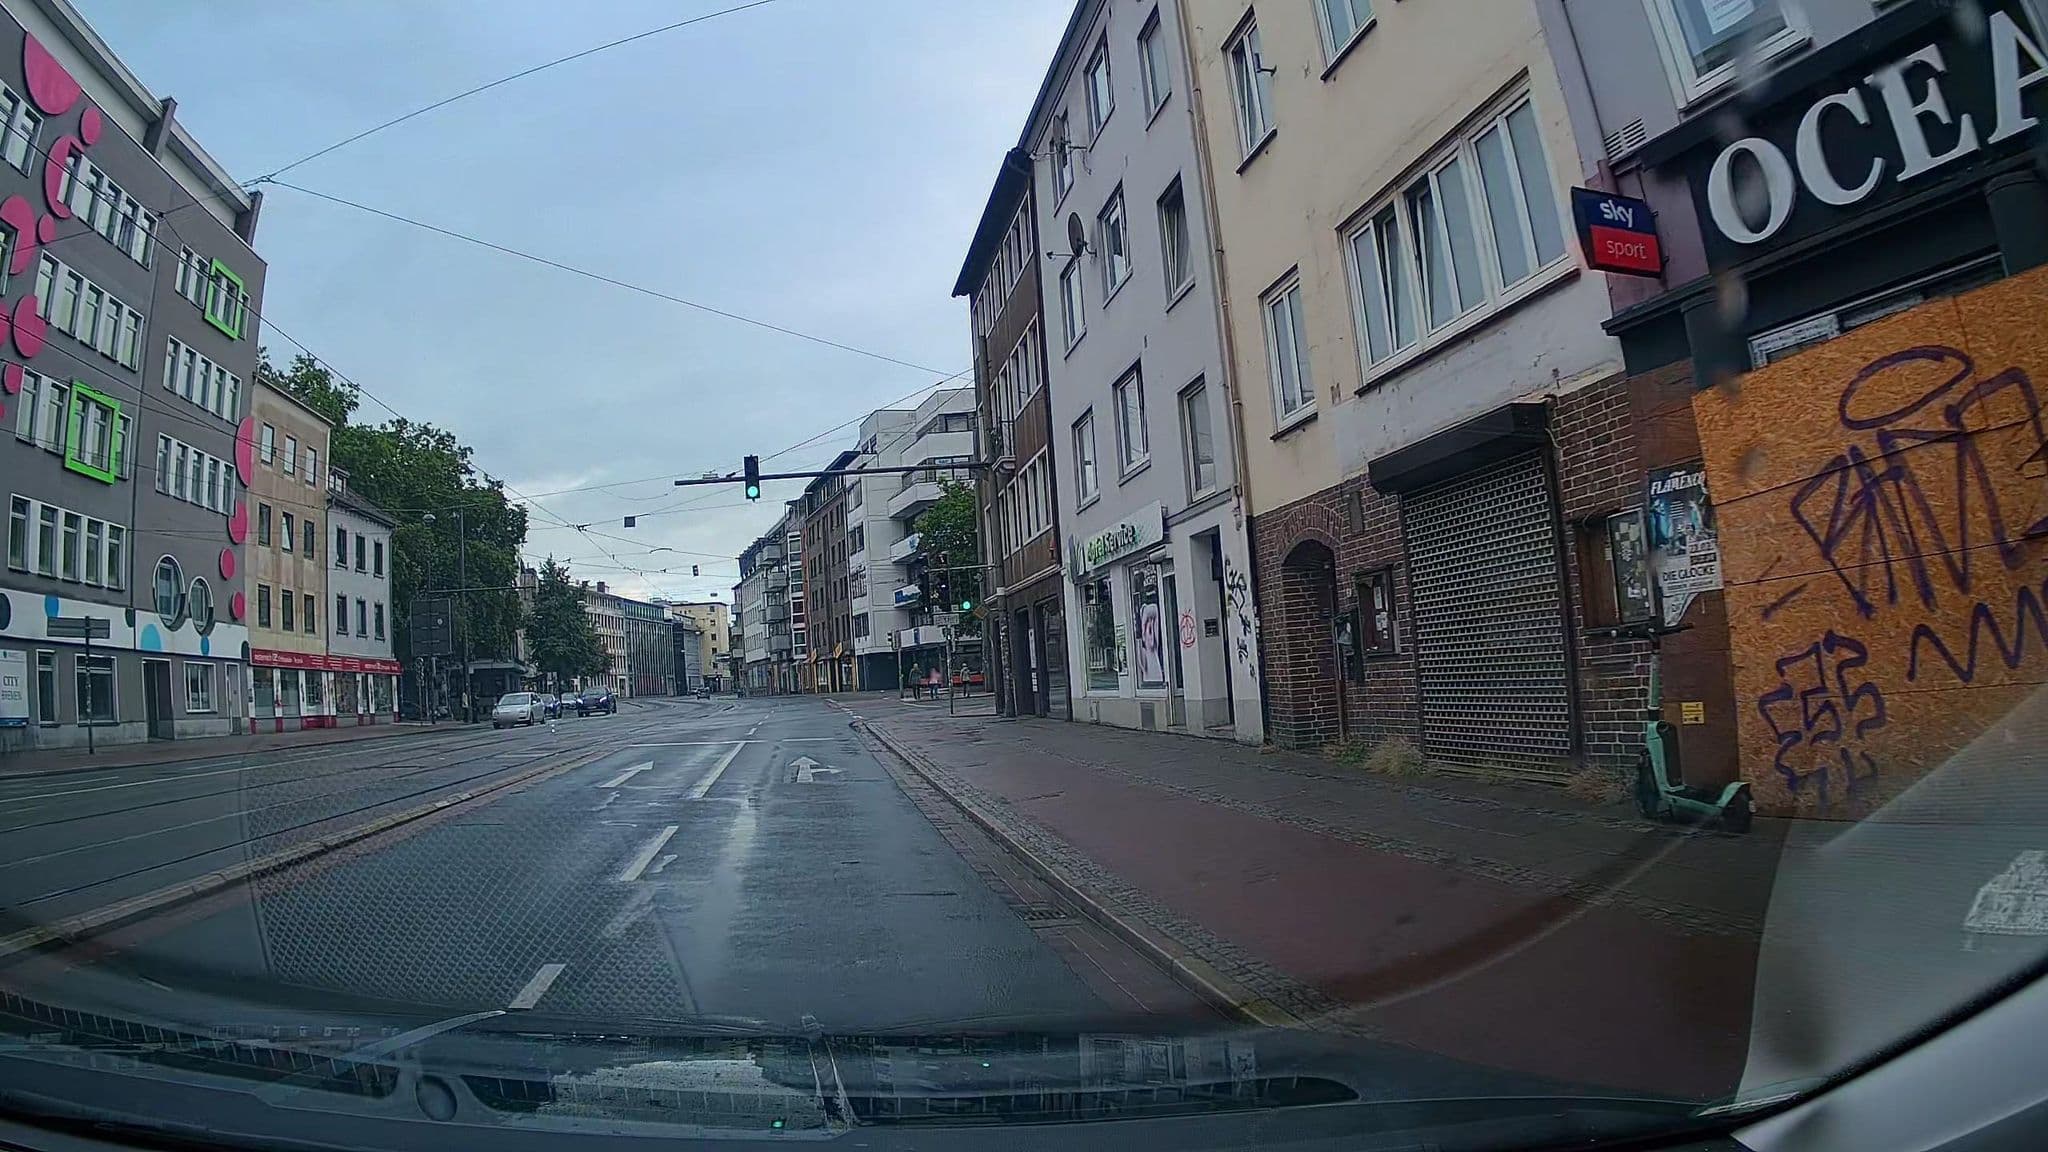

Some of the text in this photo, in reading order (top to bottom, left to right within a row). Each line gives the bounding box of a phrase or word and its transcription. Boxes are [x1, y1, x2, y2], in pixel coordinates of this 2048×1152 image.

[1707, 10, 2048, 244] OCEA
[1600, 199, 1633, 228] sky
[1606, 240, 1648, 259] sport
[1679, 564, 1715, 580] GLOCKE
